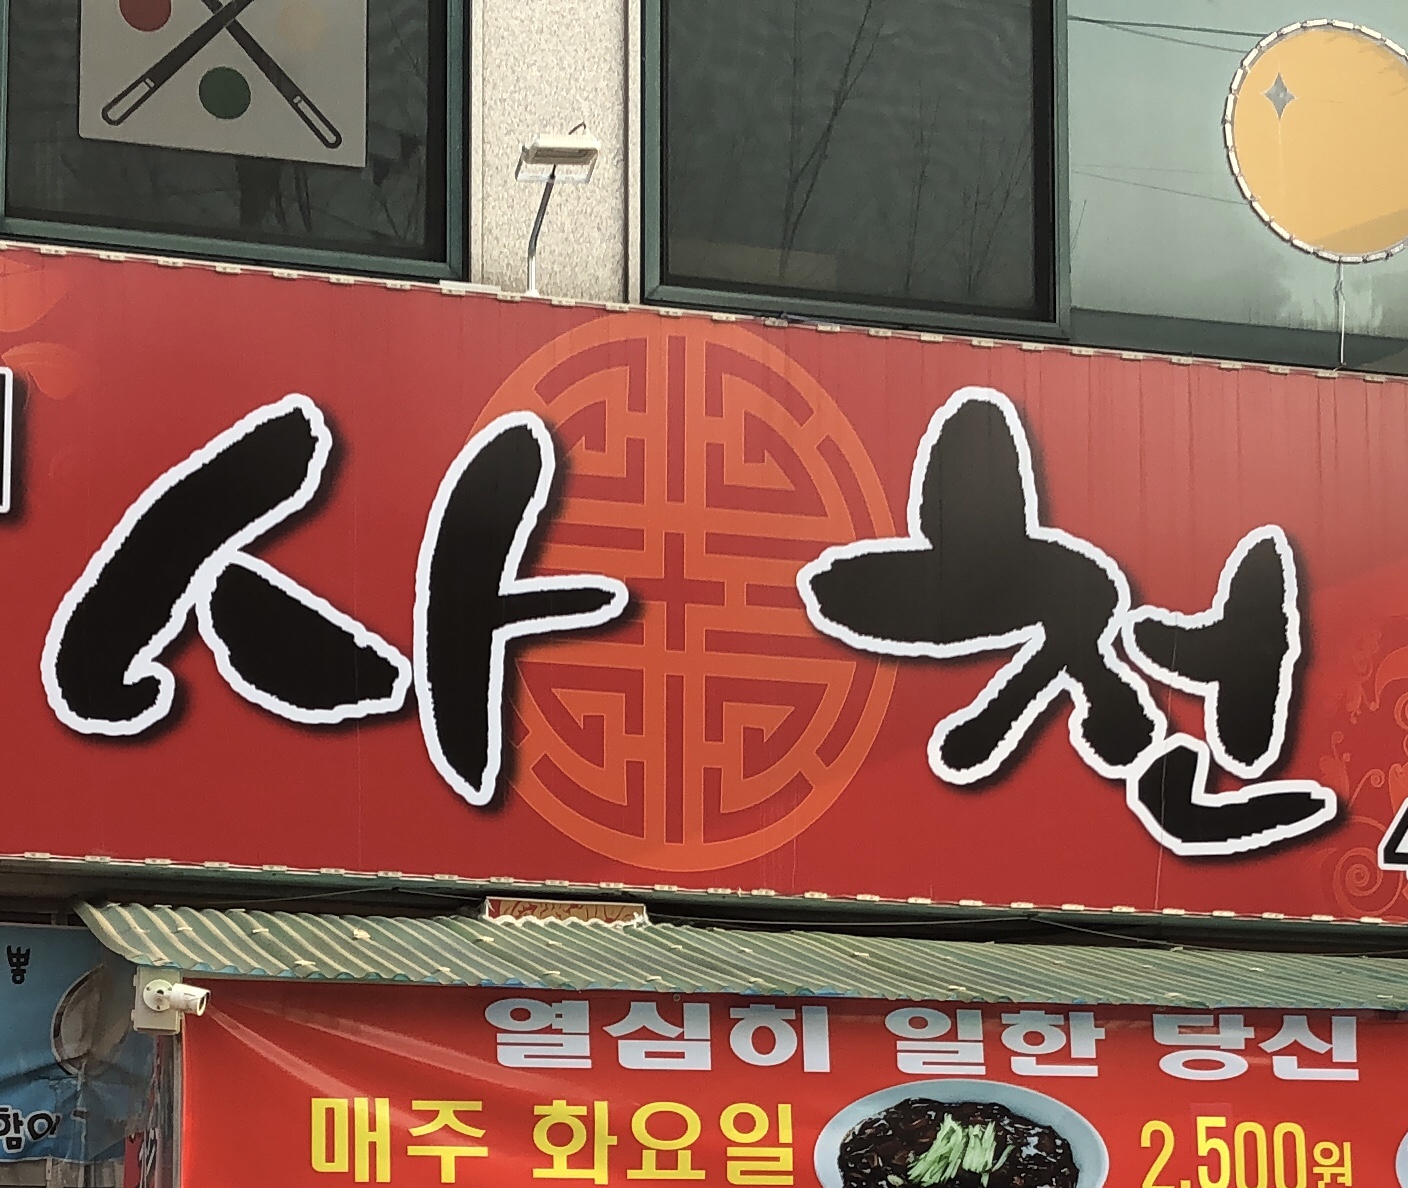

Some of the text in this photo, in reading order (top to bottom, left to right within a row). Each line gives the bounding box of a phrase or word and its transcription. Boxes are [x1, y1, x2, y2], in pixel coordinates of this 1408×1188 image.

[41, 386, 1337, 855] 사천
[484, 997, 831, 1074] 열심히
[884, 1006, 1106, 1077] 일한
[1151, 1012, 1360, 1082] 당신
[309, 1097, 794, 1187] 매주 화요일
